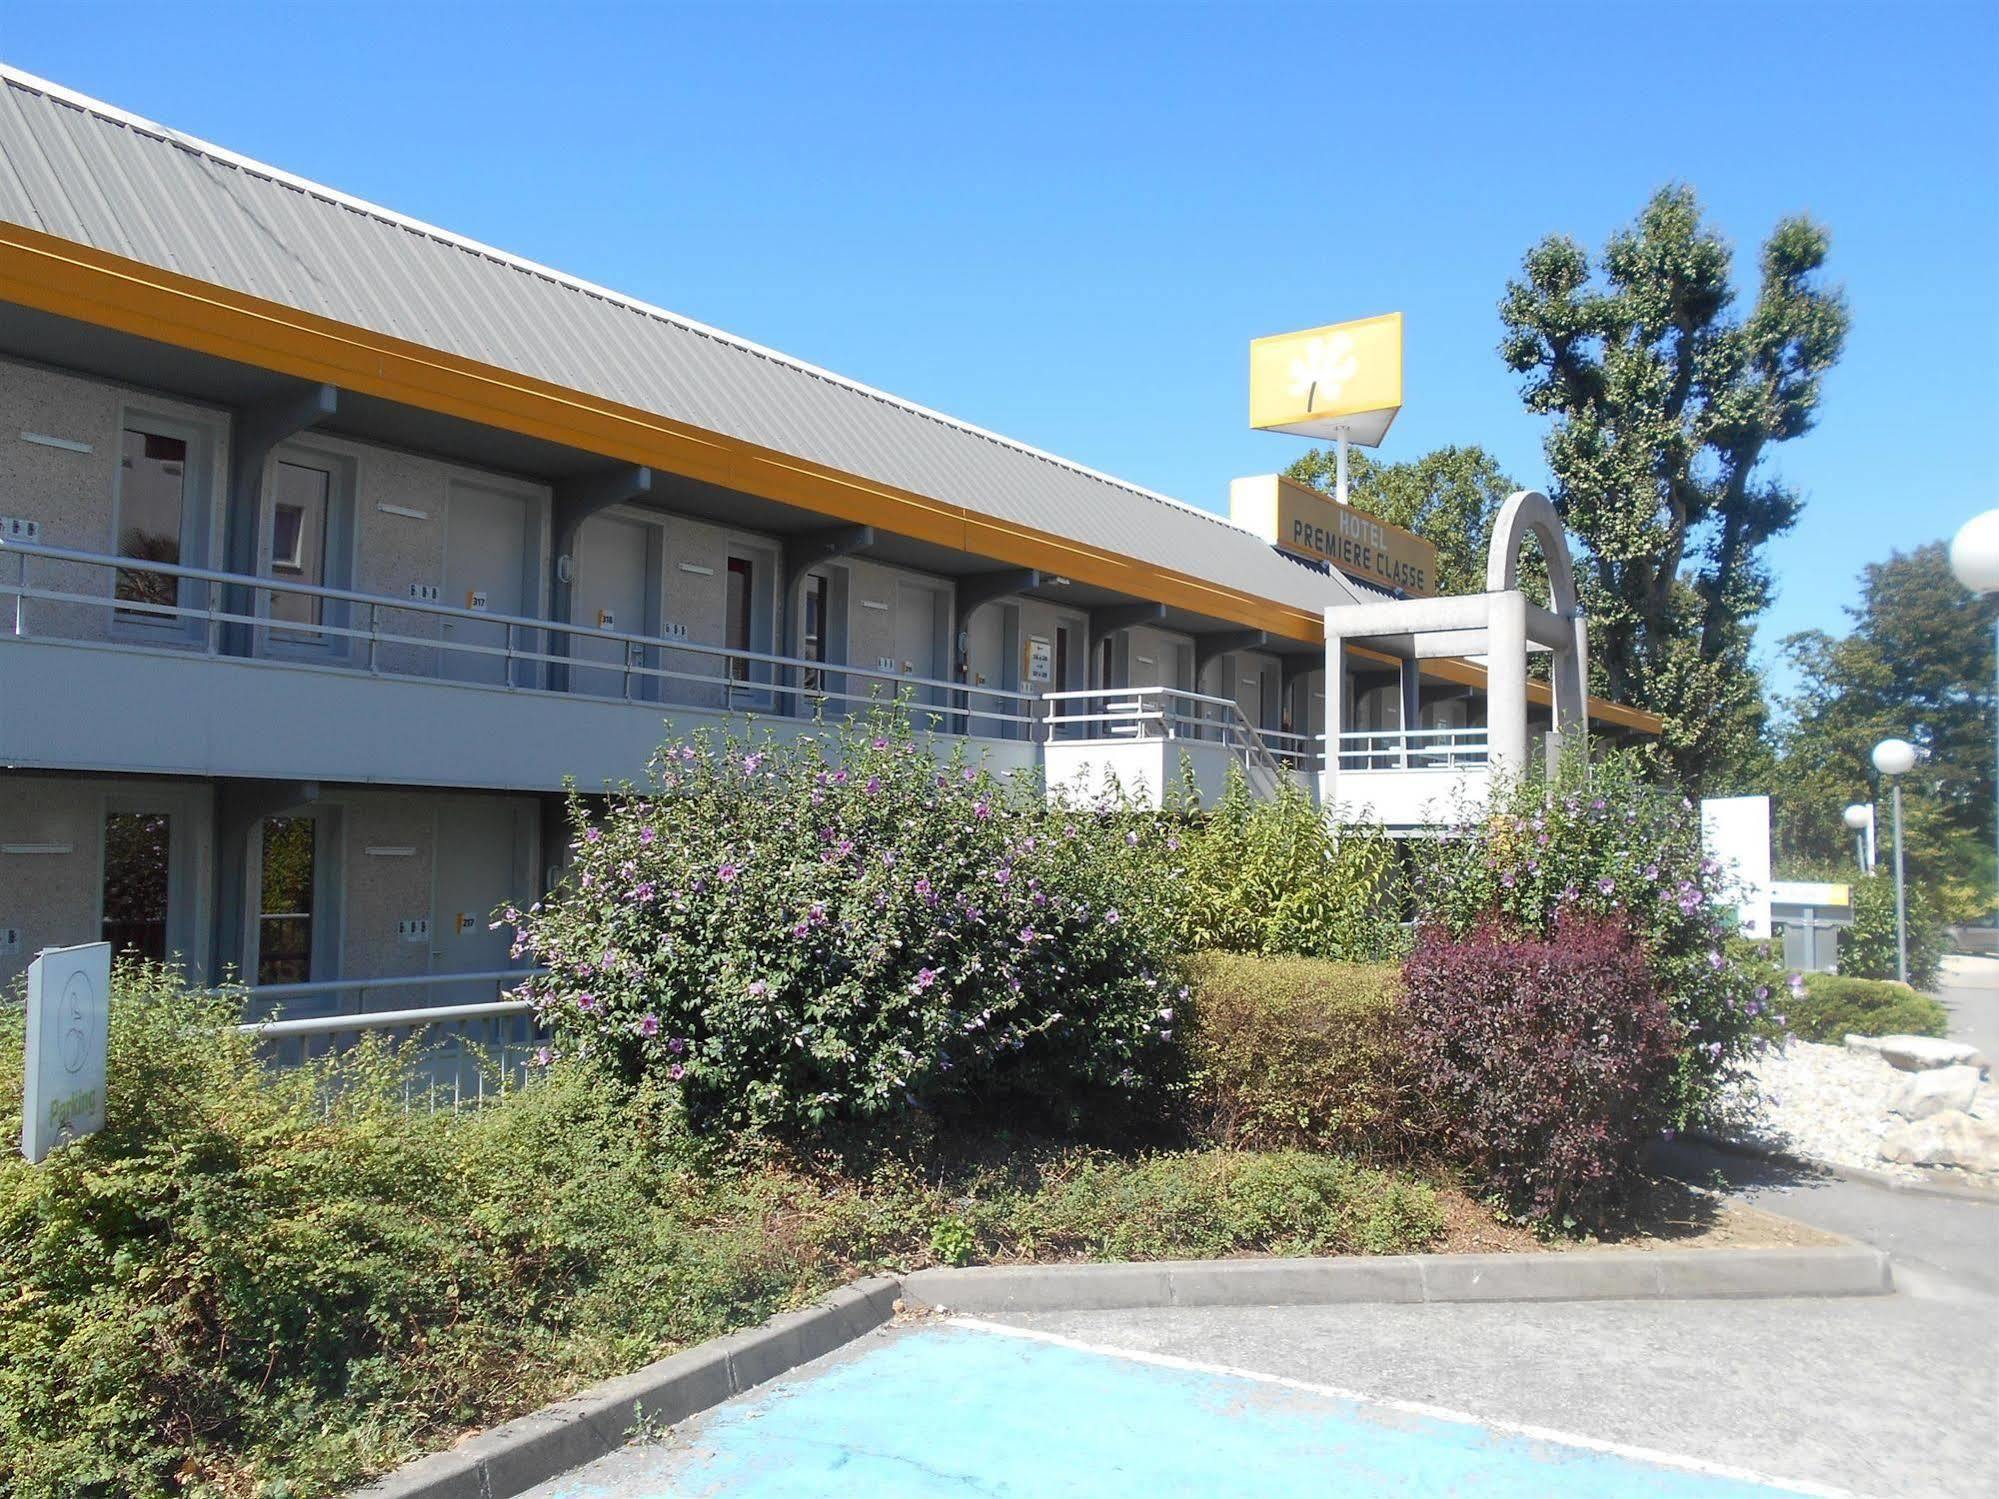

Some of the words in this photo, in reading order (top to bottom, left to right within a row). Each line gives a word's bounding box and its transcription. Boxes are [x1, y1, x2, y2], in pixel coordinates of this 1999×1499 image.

[1340, 510, 1387, 550] HOTEL
[1294, 520, 1370, 569] PREMIERE
[1377, 552, 1424, 590] CLASSE
[472, 597, 485, 606] 317
[49, 1089, 96, 1127] Parking
